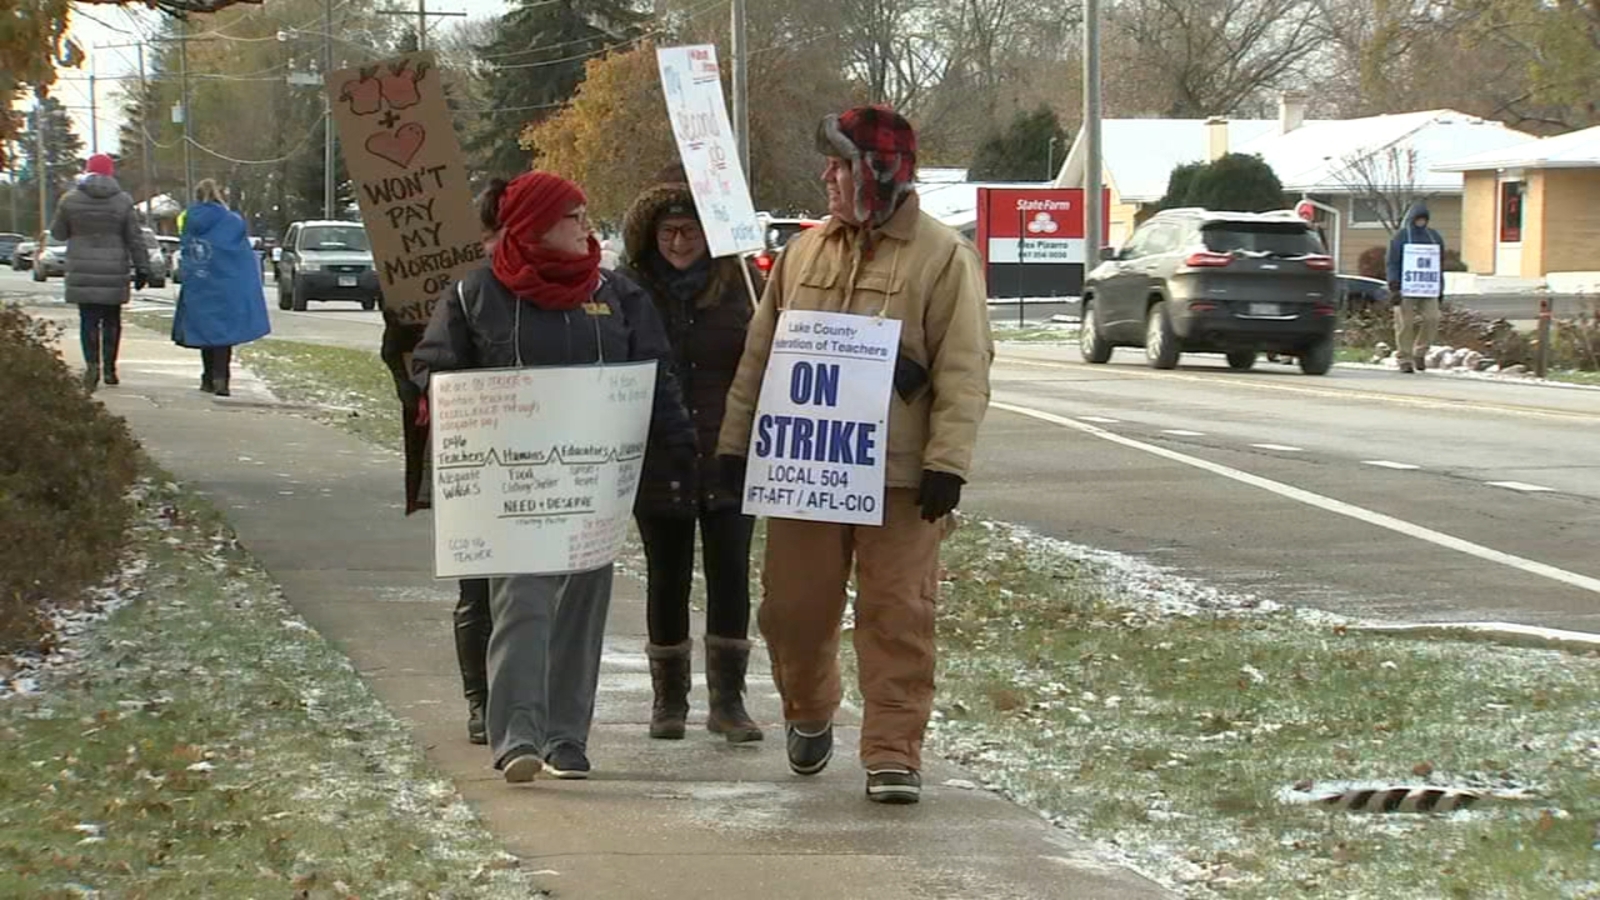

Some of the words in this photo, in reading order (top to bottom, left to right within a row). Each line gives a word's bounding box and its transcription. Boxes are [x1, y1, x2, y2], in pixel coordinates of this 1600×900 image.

[363, 165, 447, 206] WON'T
[386, 198, 435, 230] PAY
[401, 222, 442, 254] MY
[384, 242, 485, 286] MORTGAGE
[788, 321, 811, 334] Lake
[813, 322, 858, 340] County
[815, 340, 829, 351] of
[831, 341, 888, 357] Teachers
[789, 361, 840, 407] ON
[755, 413, 877, 467] STRIKE
[438, 451, 486, 465] Teachers
[503, 448, 545, 463] Humans
[767, 465, 816, 486] LOCAL
[820, 469, 849, 488] 504
[503, 498, 537, 514] NEED
[546, 497, 594, 511] DESERVE
[806, 491, 877, 513] AFL-CIO
